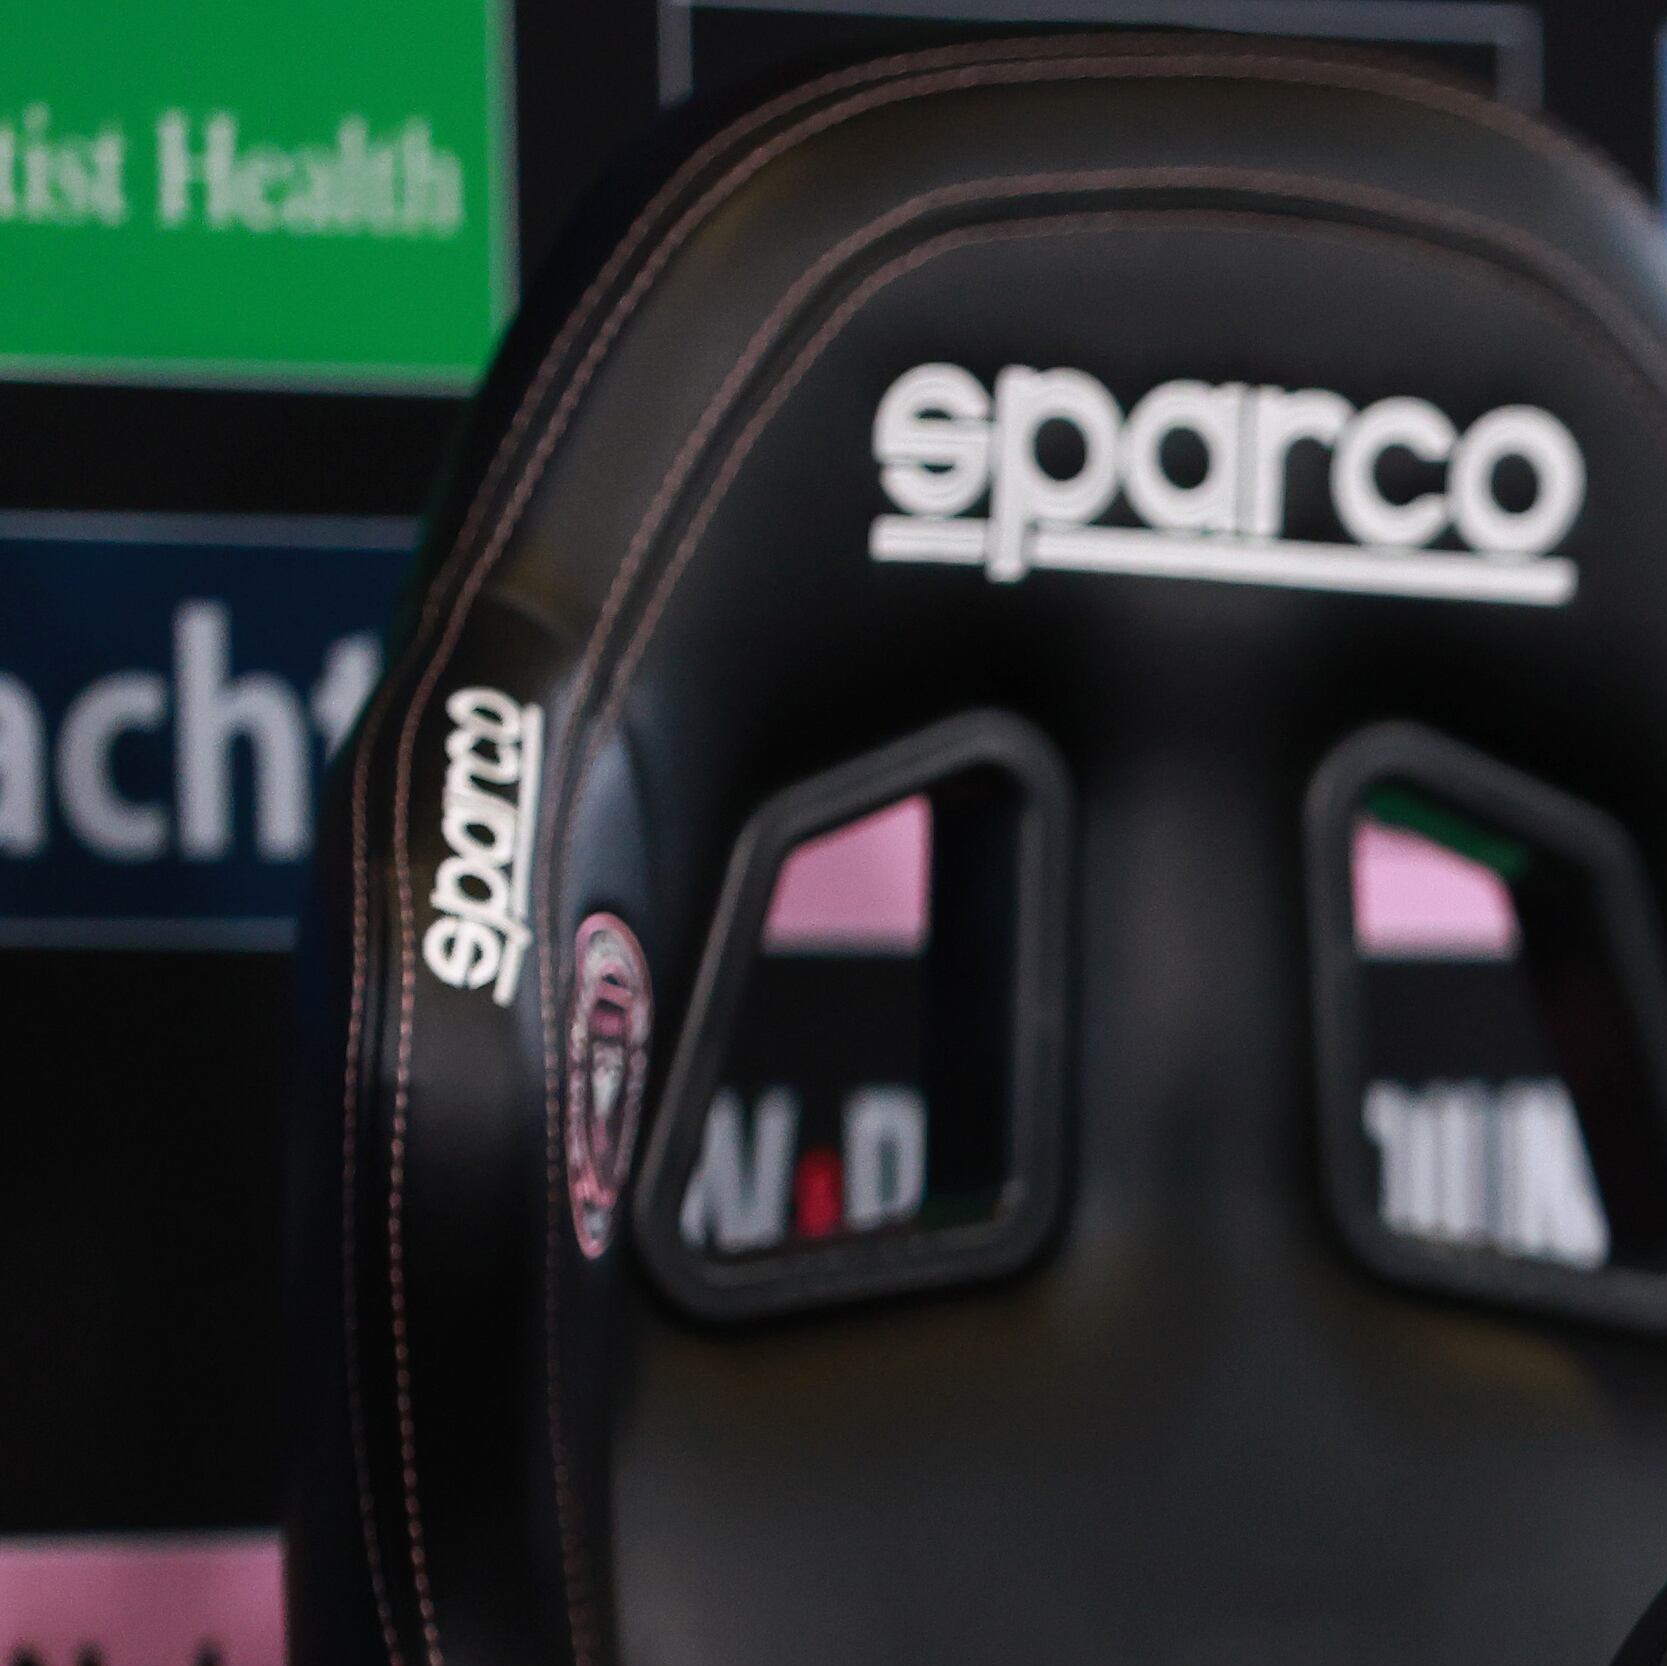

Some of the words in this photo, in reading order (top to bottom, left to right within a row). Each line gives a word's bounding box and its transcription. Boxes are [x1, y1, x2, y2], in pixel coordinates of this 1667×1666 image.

[155, 108, 466, 238] Health
[870, 362, 1587, 600] sparco
[423, 688, 544, 1005] sparco
